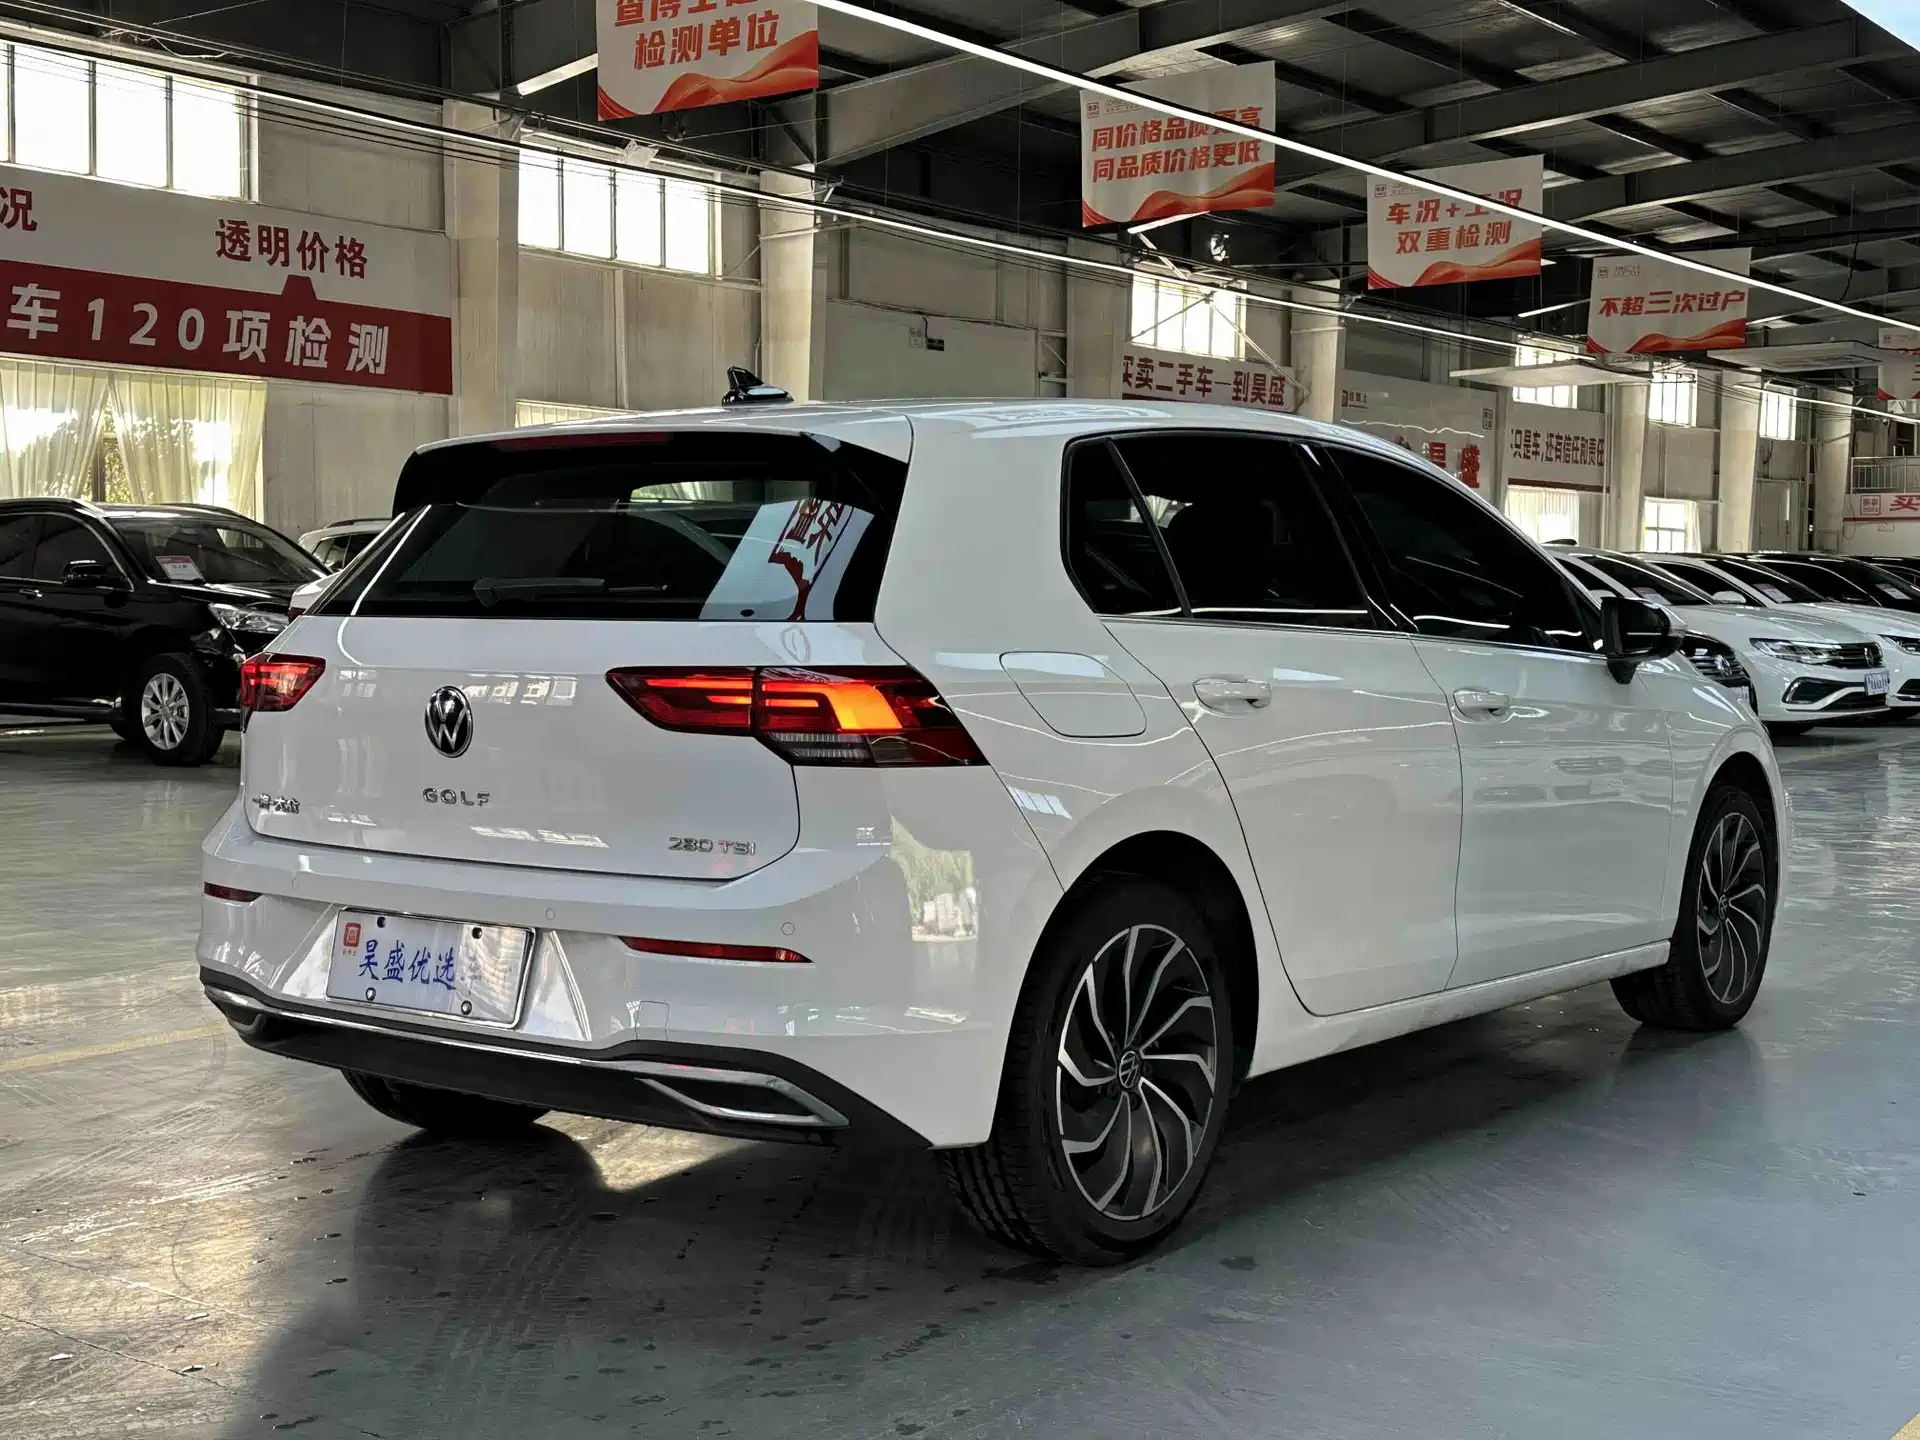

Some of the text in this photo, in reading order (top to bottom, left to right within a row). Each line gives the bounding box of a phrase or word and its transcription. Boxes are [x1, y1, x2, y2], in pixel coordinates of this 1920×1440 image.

[634, 9, 779, 70] 检测单位
[1093, 139, 1261, 182] 同品质价格更低
[0, 187, 368, 279] 况 透明价格
[1396, 220, 1512, 254] 双重检测
[1599, 290, 1746, 317] 不超三次过户
[422, 787, 491, 808] GOLF
[668, 836, 756, 856] 280 TSI
[359, 939, 456, 990] 昊盛优选
